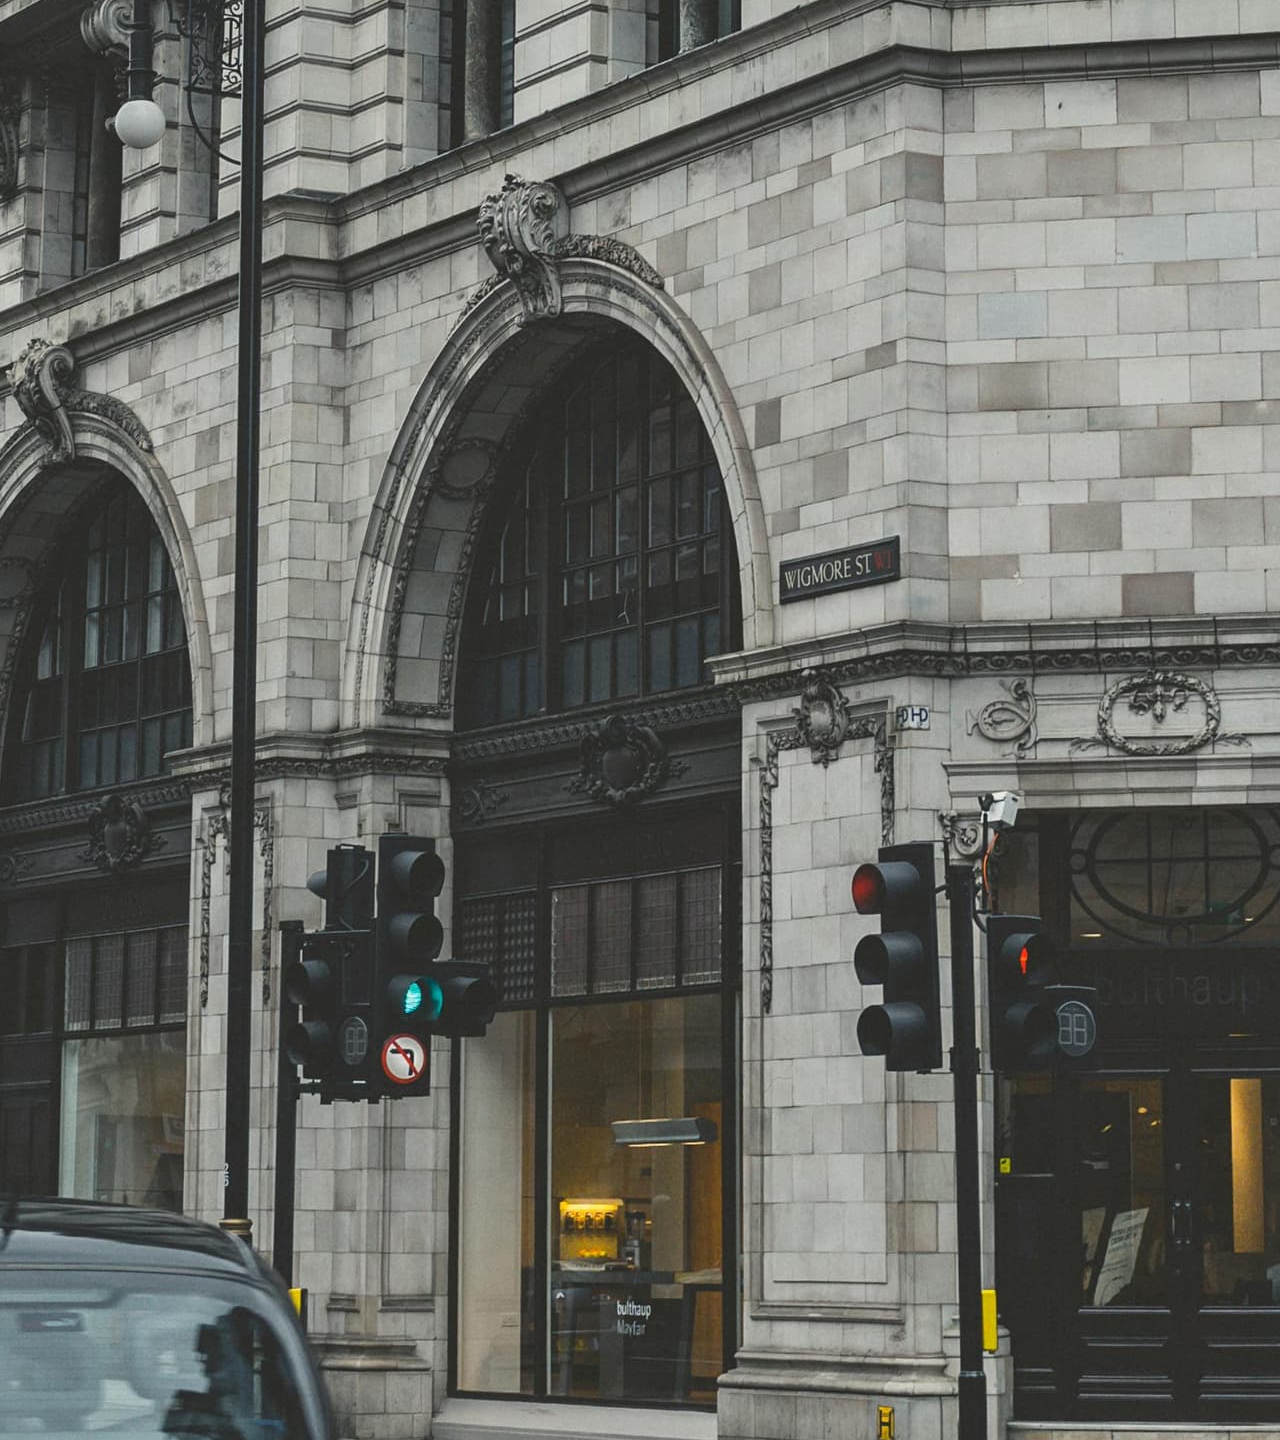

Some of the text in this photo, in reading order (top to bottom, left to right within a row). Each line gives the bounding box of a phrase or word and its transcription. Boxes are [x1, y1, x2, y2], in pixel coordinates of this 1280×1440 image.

[784, 558, 851, 590] WIGMORE
[617, 1300, 651, 1320] bulthaup
[617, 1320, 646, 1337] Mayfair
